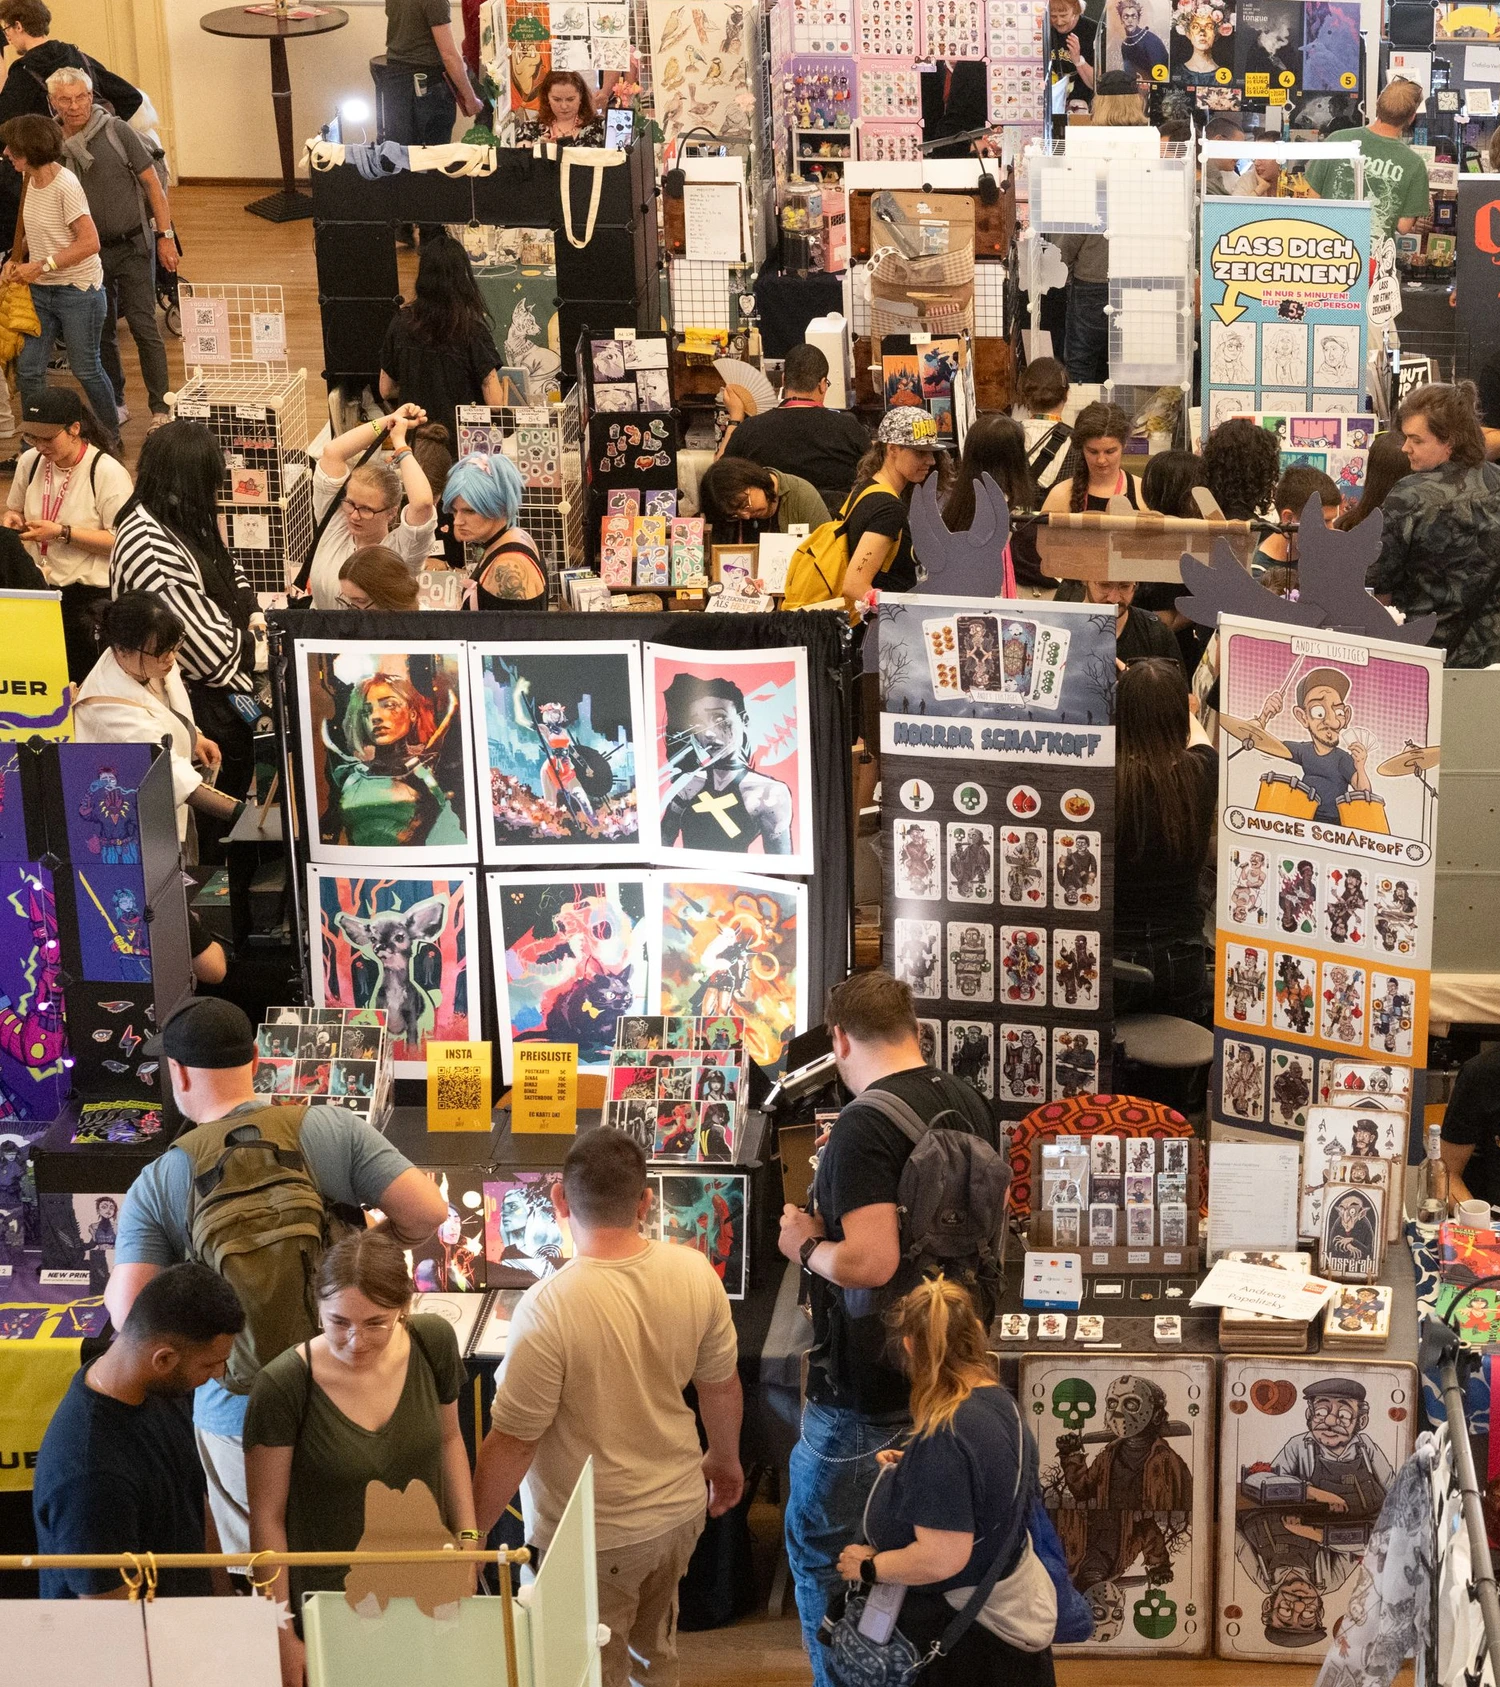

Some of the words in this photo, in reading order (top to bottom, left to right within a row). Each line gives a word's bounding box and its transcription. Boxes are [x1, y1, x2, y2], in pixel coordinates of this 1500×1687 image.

[1243, 14, 1268, 22] tongue
[1156, 68, 1164, 77] 2
[1220, 71, 1227, 80] 3
[1283, 75, 1291, 83] 4
[1344, 75, 1353, 85] 5
[1219, 235, 1282, 256] LASS
[1288, 238, 1354, 260] DICH
[1213, 261, 1358, 286] ZEICHNEN!
[1379, 280, 1388, 290] LASS
[1262, 290, 1270, 298] IN
[1273, 291, 1293, 299] NUR
[1296, 291, 1302, 299] 5
[1305, 291, 1348, 300] MINUTEN!
[1322, 302, 1360, 310] PERSON
[713, 599, 729, 608] ALS
[1295, 639, 1321, 654] ANDI'S
[1327, 645, 1365, 662] LUSTIGES
[0, 681, 48, 696] UER
[893, 721, 974, 750] HORROR
[981, 727, 1101, 759] SCHAFKOPF
[1247, 817, 1305, 837] MUCKE
[1311, 825, 1403, 856] SCHAFKOPF
[445, 1049, 473, 1060] INSTA
[520, 1050, 572, 1062] PREISLISTE
[1317, 1118, 1327, 1133] A
[1386, 1124, 1395, 1137] A
[47, 1271, 68, 1280] NEW
[1239, 1285, 1287, 1300] Andreas
[1228, 1291, 1284, 1310] Papelitzky
[1032, 1383, 1045, 1398] O
[1187, 1384, 1201, 1400] O
[1231, 1382, 1246, 1398] O
[1390, 1388, 1405, 1405] O
[0, 1451, 37, 1468] UE
